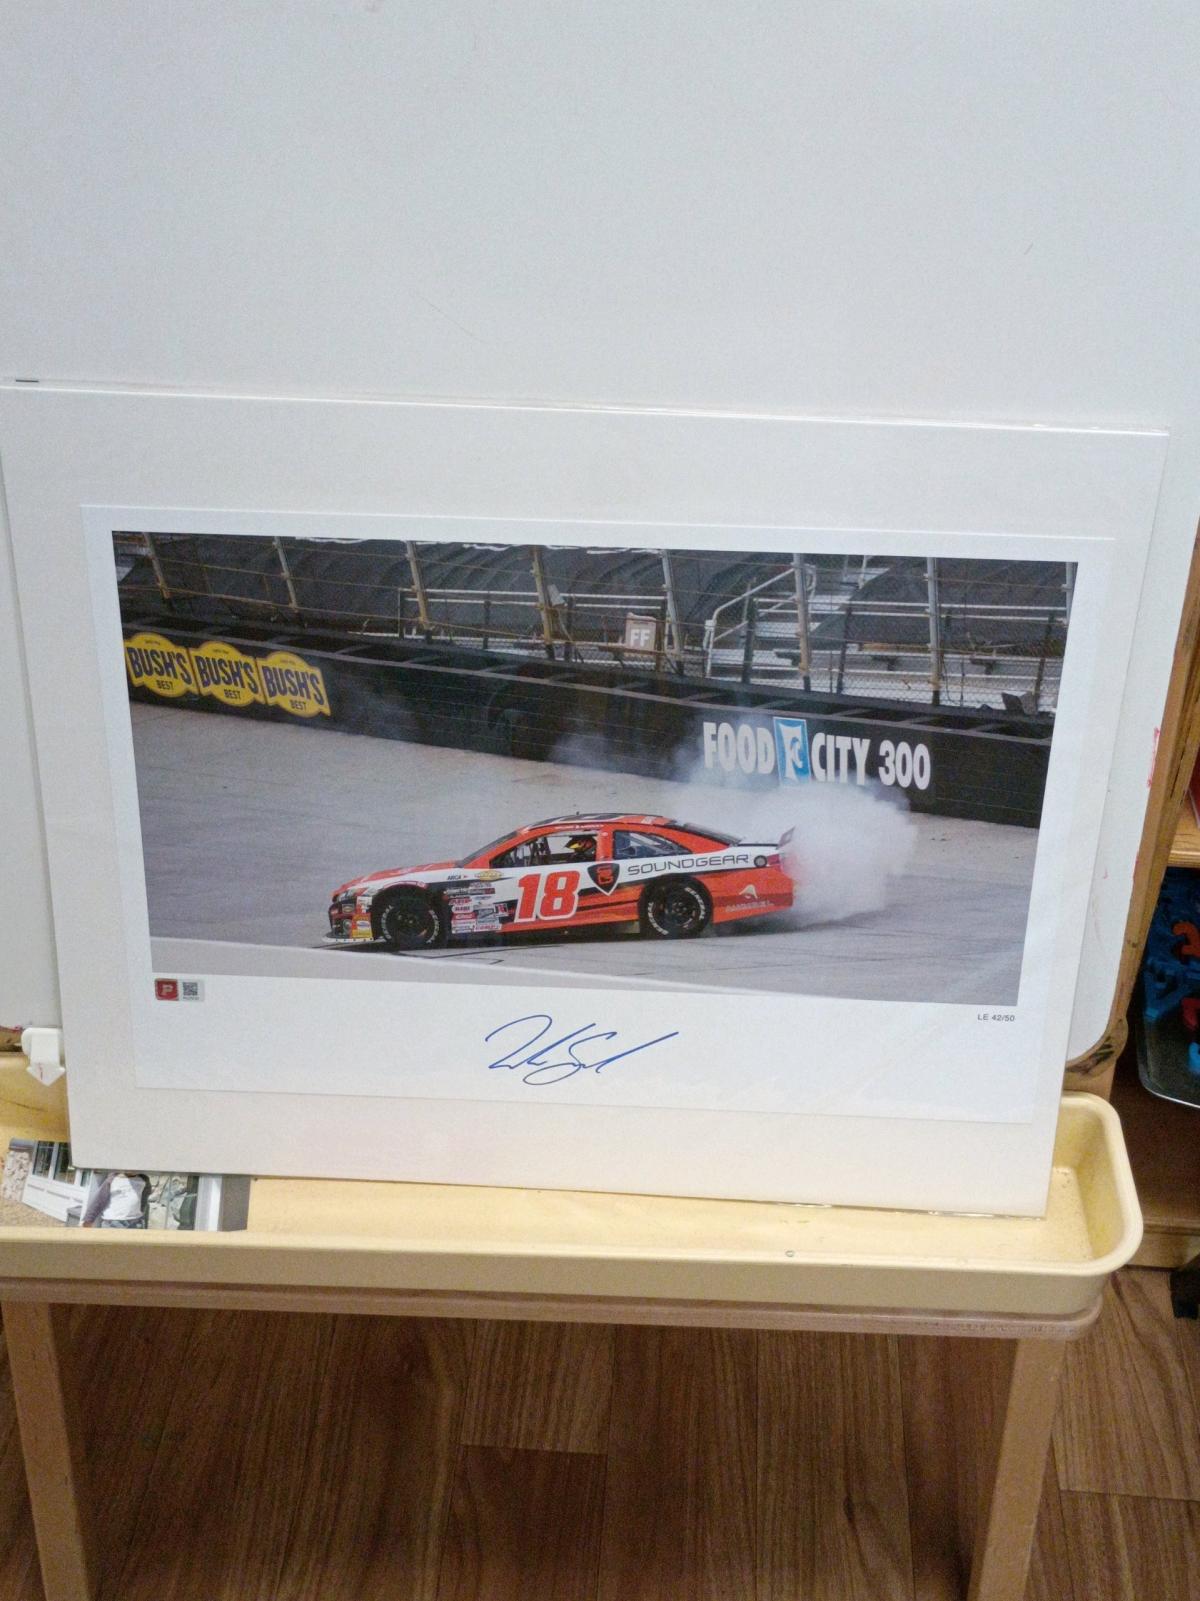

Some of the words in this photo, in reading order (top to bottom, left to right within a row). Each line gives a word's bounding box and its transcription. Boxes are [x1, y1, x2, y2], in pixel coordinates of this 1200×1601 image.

[127, 647, 193, 685] BUSH'S
[194, 655, 260, 695] BUSH'S
[155, 679, 174, 691] BEST
[223, 688, 241, 700] BEST
[261, 665, 325, 706] BUSH'S
[290, 699, 307, 711] BEST
[702, 721, 776, 775] FOOD
[811, 732, 871, 786] CITY
[878, 739, 931, 791] 300
[627, 854, 749, 876] SOUNDGEAR
[514, 869, 581, 923] 18
[977, 1013, 989, 1021] LE
[991, 1014, 1015, 1022] 42/50
